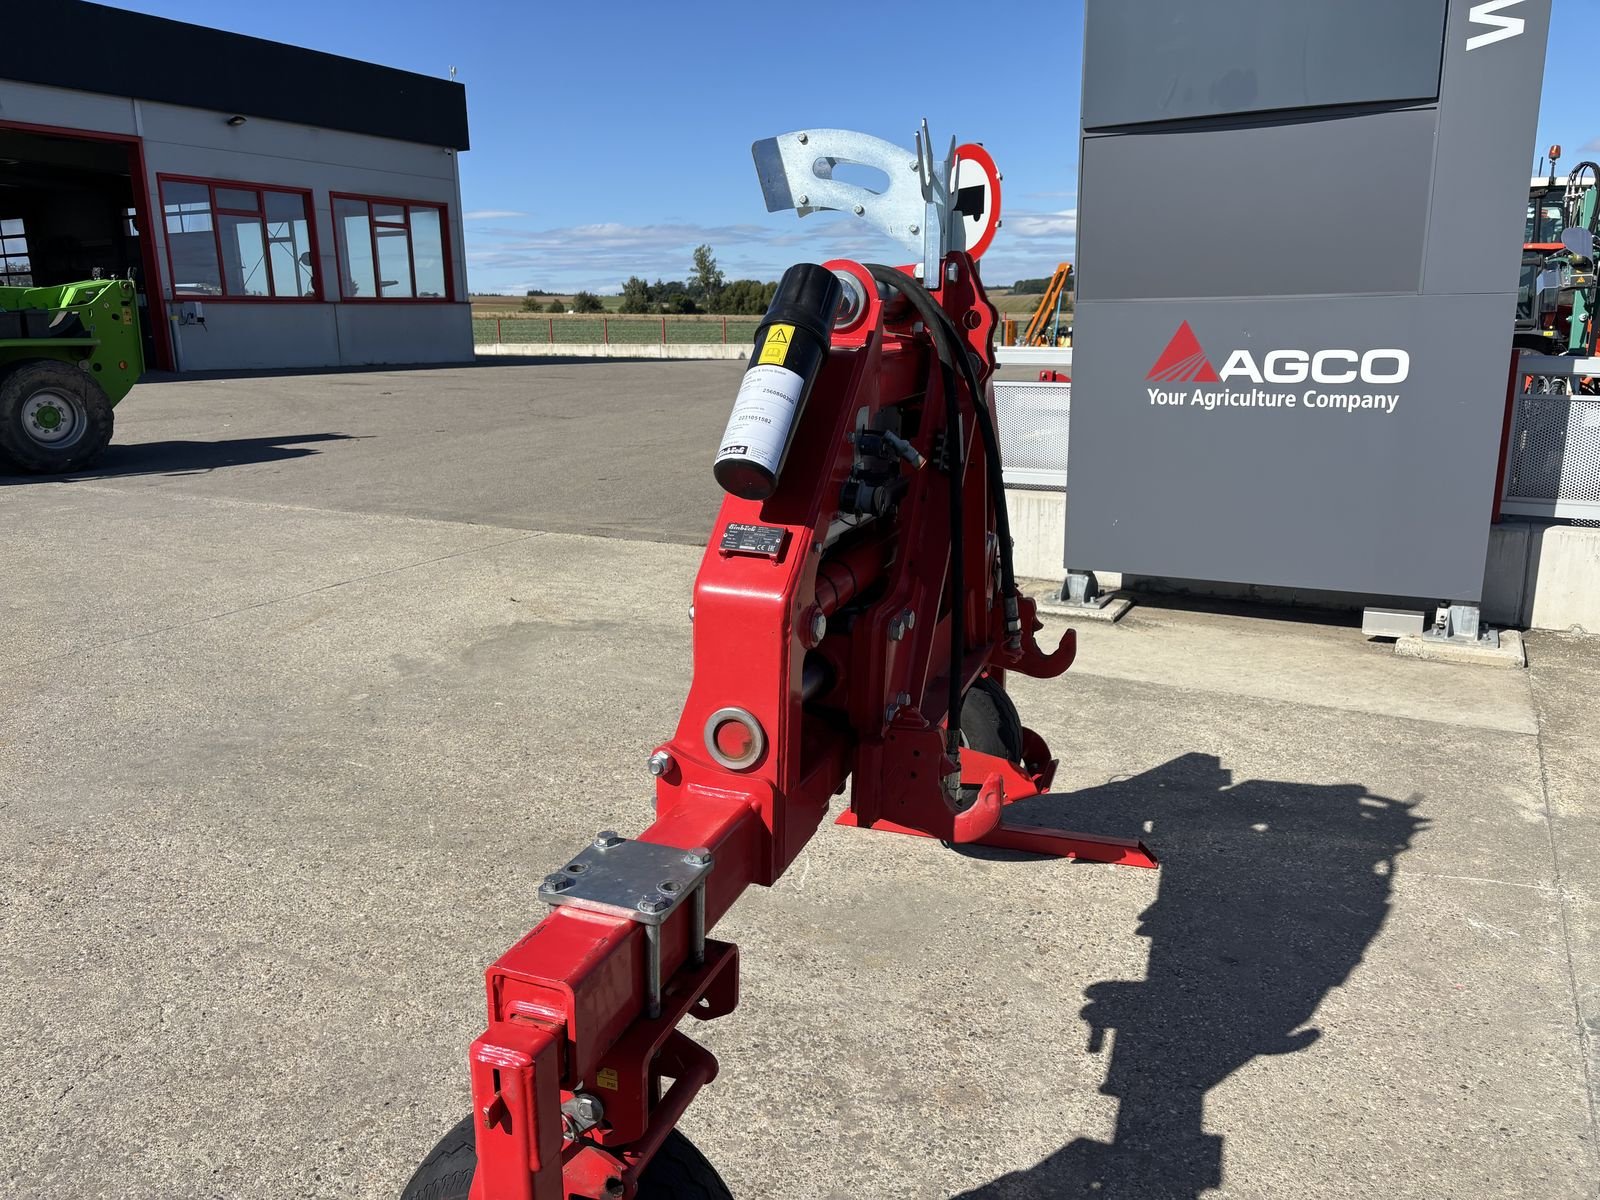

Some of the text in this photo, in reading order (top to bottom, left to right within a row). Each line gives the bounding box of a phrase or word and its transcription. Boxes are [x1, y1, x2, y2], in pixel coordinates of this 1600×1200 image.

[1219, 348, 1410, 384] AGCO
[1147, 388, 1400, 414] Your Agriculture Company
